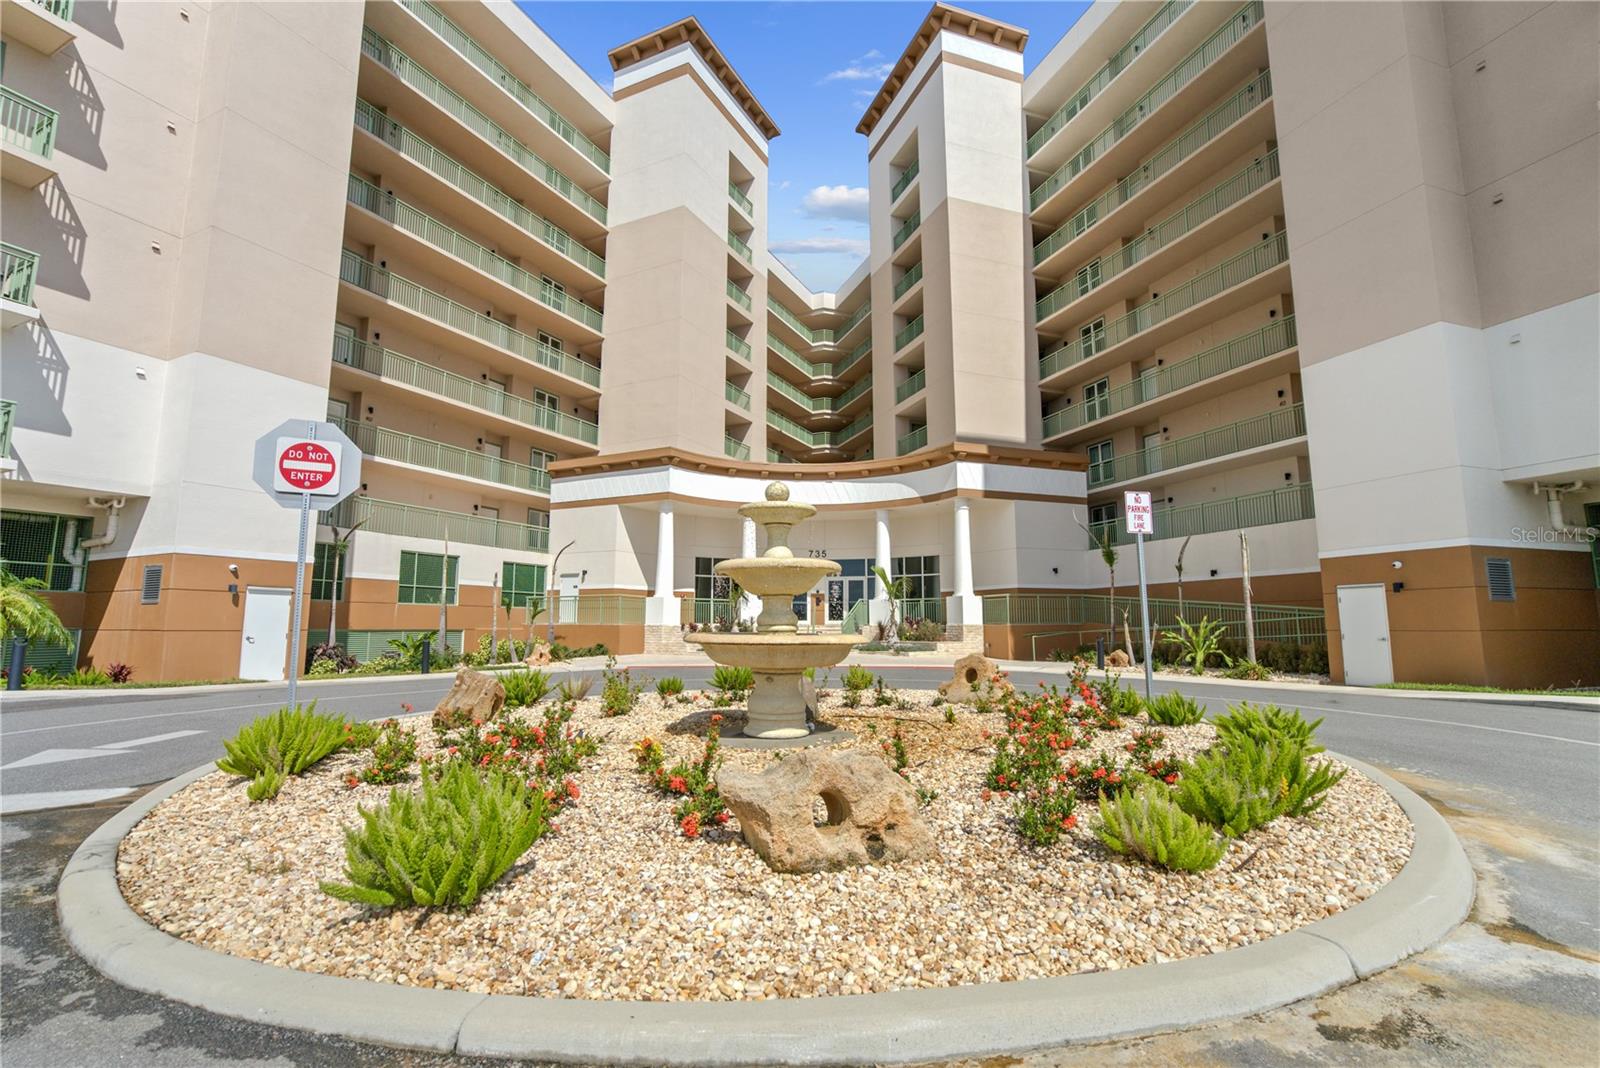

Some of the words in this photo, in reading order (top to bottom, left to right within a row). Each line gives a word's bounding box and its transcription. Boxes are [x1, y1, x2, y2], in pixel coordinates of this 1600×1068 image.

[288, 449, 303, 459] DO
[308, 451, 329, 461] NOT
[290, 471, 323, 482] ENTER
[1134, 495, 1142, 504] NO
[1127, 504, 1150, 514] PARKING
[1133, 514, 1144, 522] FIRE
[1133, 522, 1146, 530] LANE
[808, 549, 827, 559] 735
